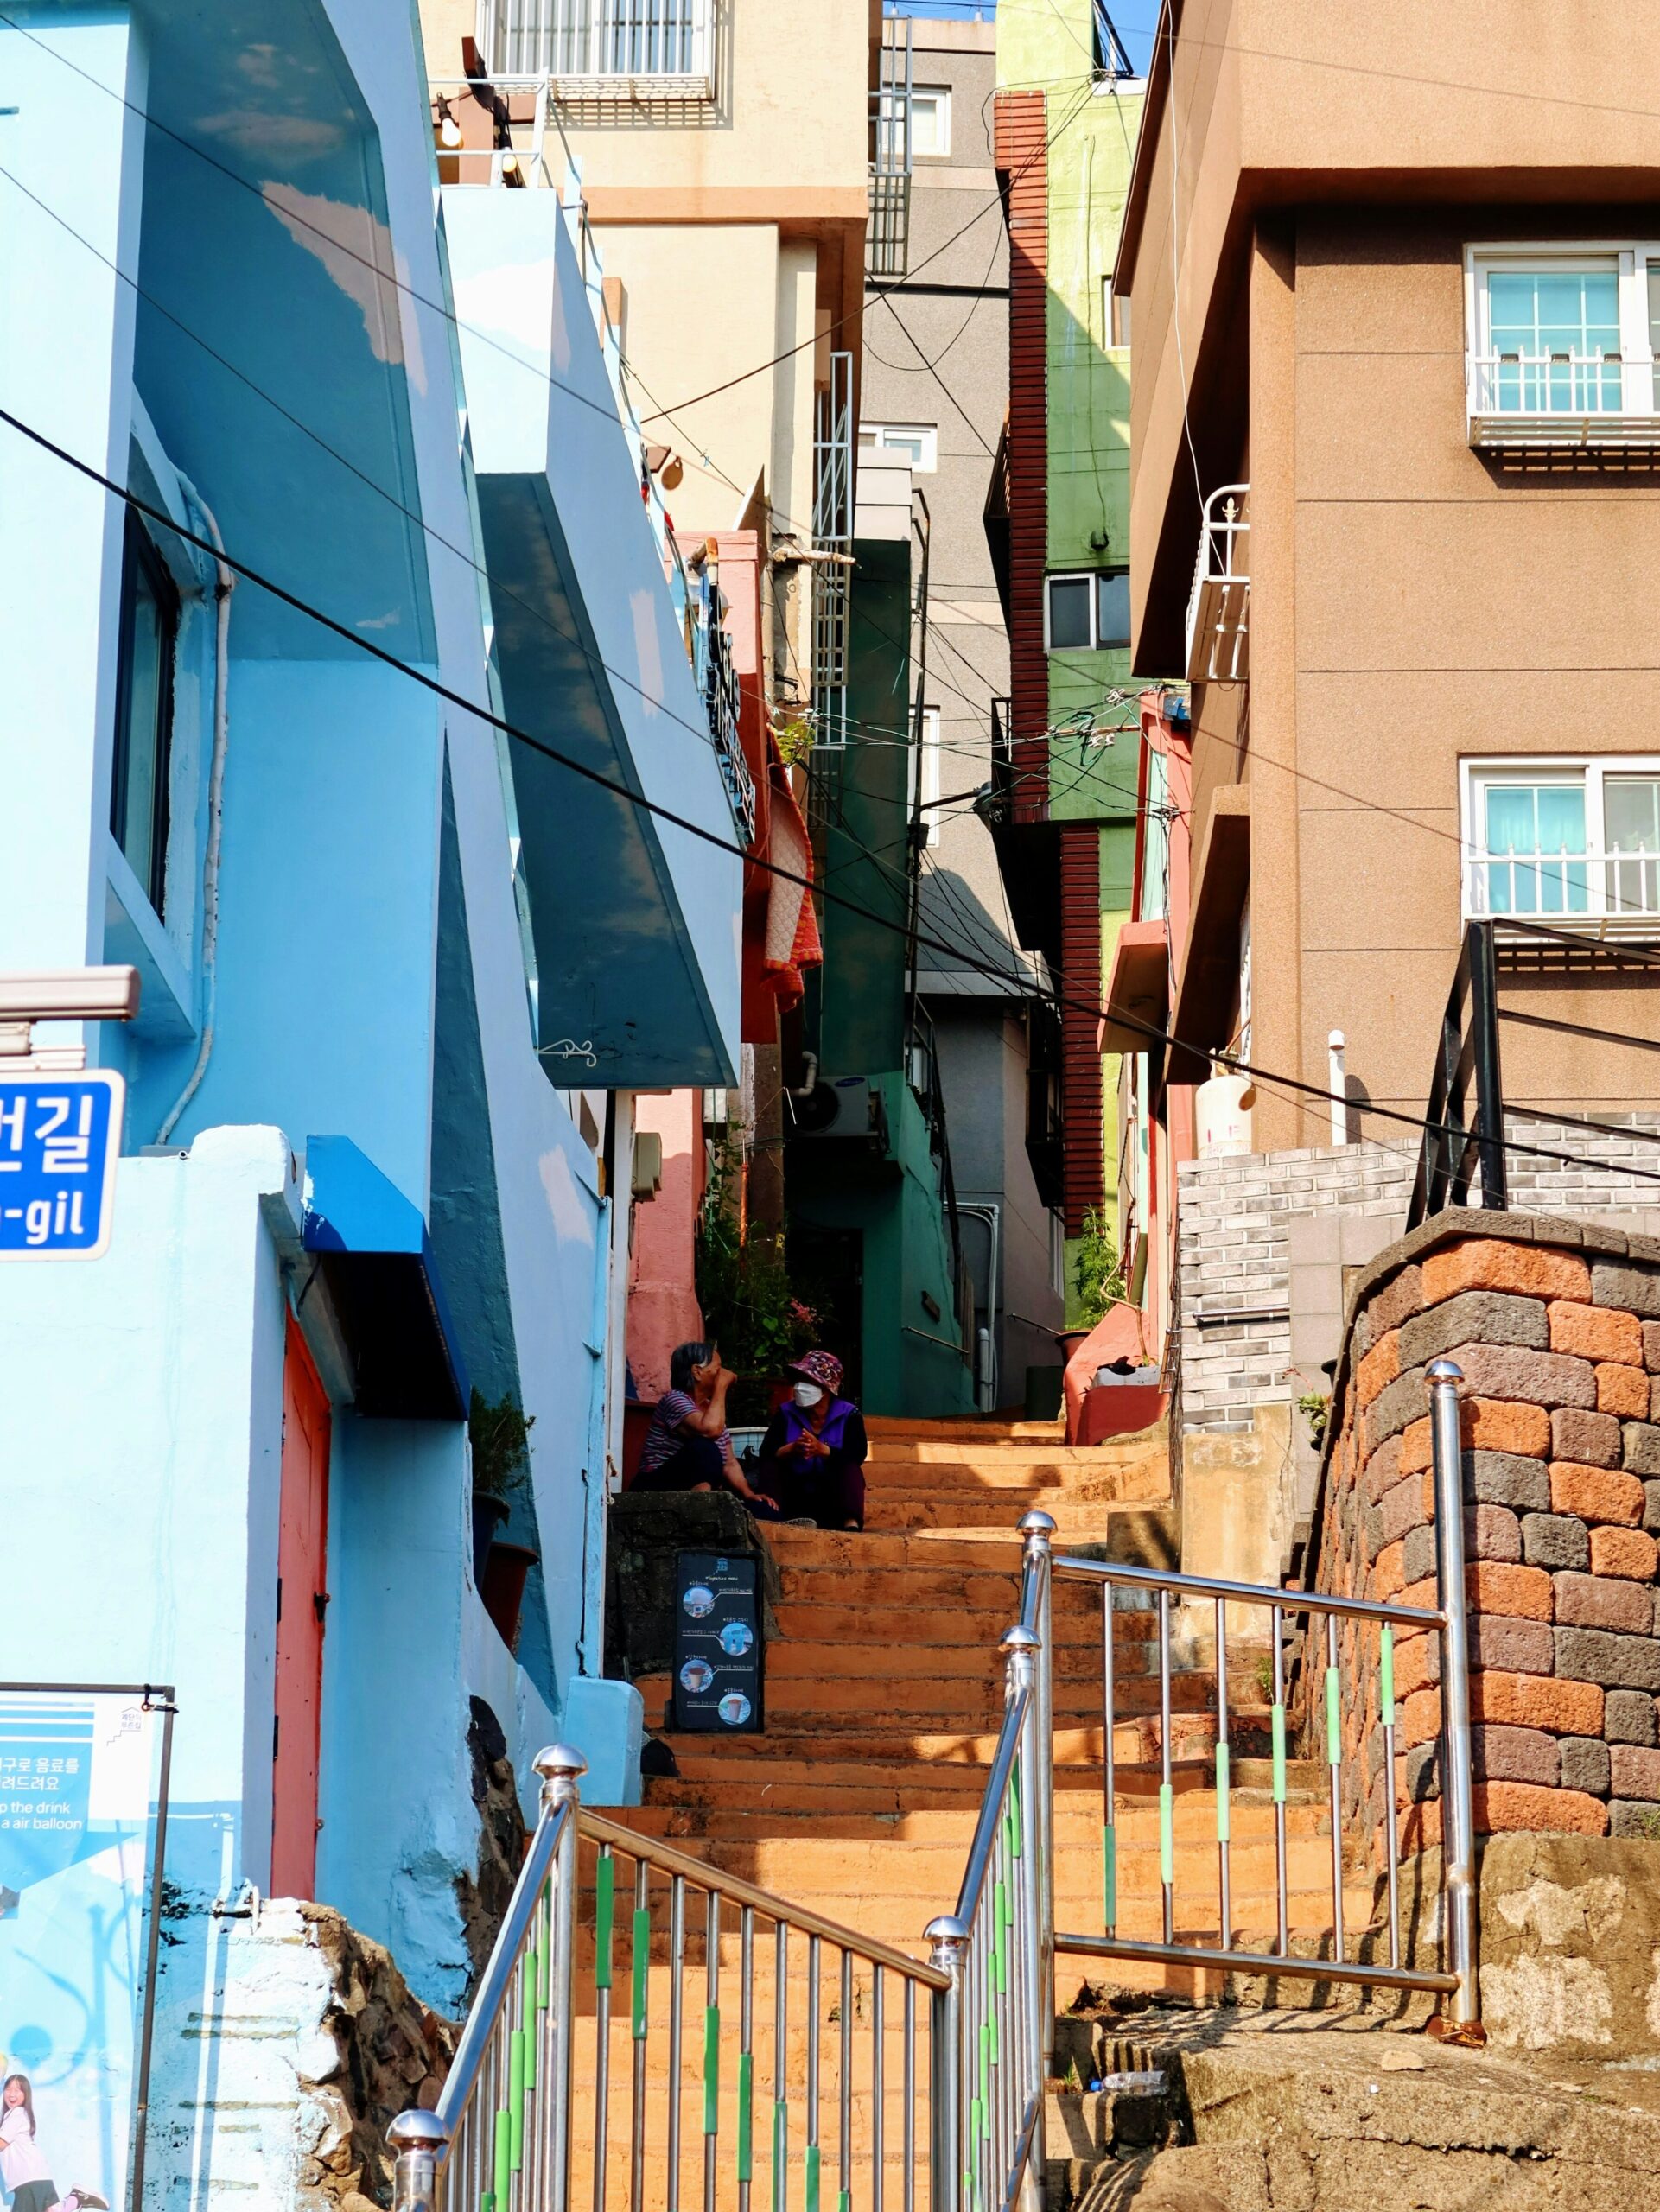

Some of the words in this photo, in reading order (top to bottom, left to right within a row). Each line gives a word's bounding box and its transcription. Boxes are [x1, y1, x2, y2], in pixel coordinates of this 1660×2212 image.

[0, 1757, 32, 1773] 구로
[35, 1758, 80, 1774] 음료를
[0, 1776, 60, 1791] 려드려요
[10, 1801, 34, 1814] the
[35, 1802, 71, 1814] drink
[1, 1819, 10, 1829] a
[12, 1817, 31, 1829] air
[33, 1818, 82, 1830] balloon
